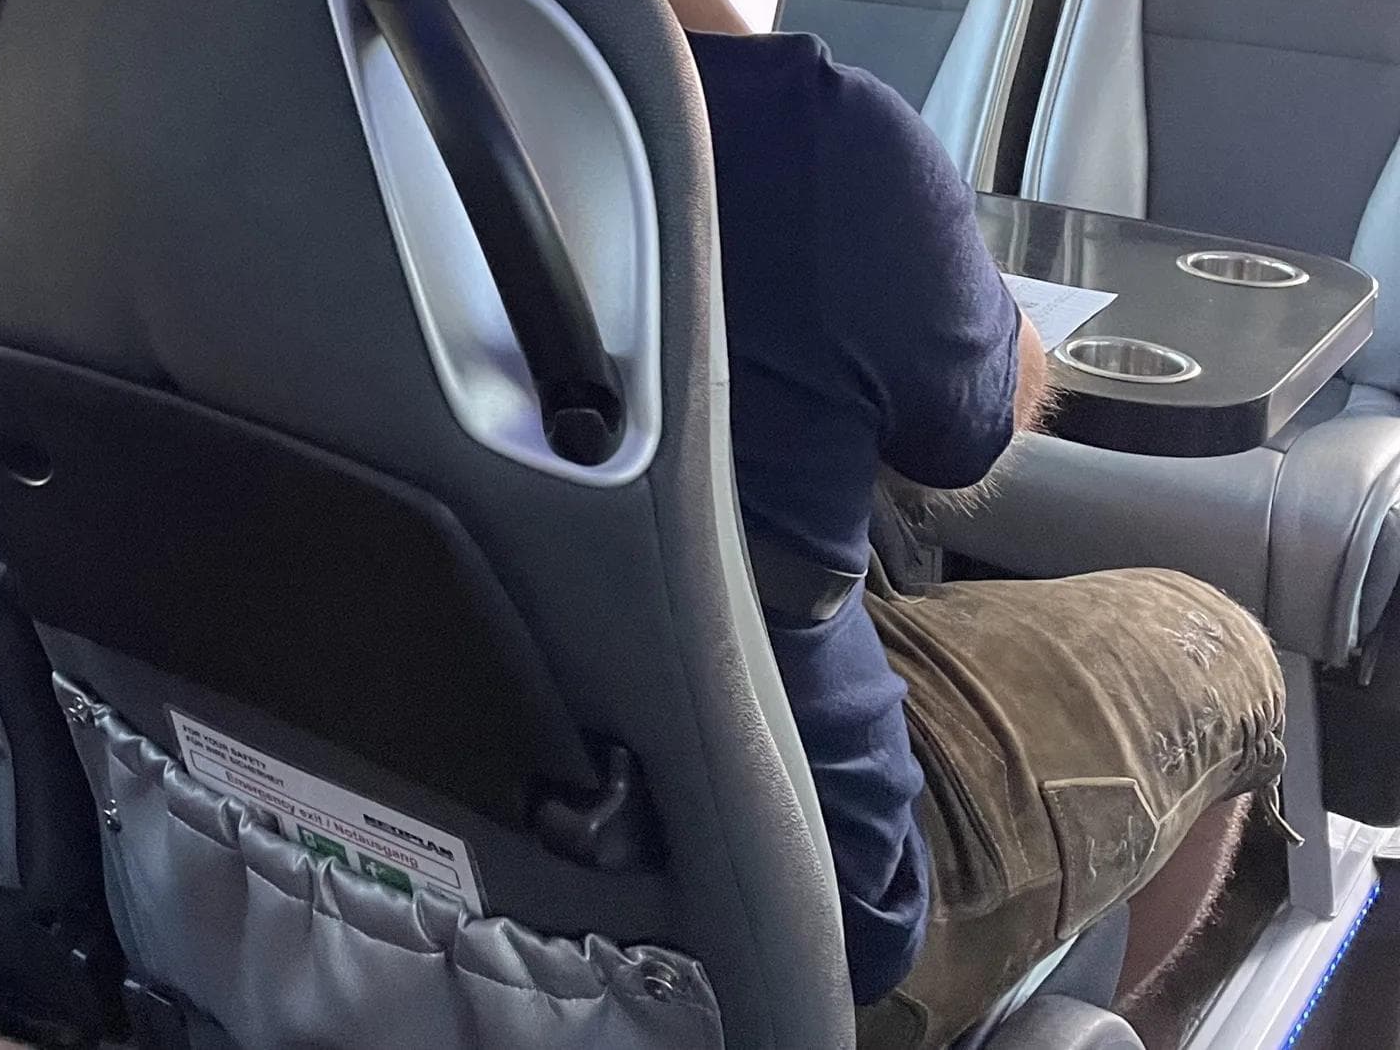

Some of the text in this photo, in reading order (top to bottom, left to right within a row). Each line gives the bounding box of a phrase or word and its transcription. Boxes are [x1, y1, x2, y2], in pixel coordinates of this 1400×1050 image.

[225, 770, 296, 815] Emergency
[298, 809, 323, 826] exit
[334, 821, 419, 869] Notausgang
